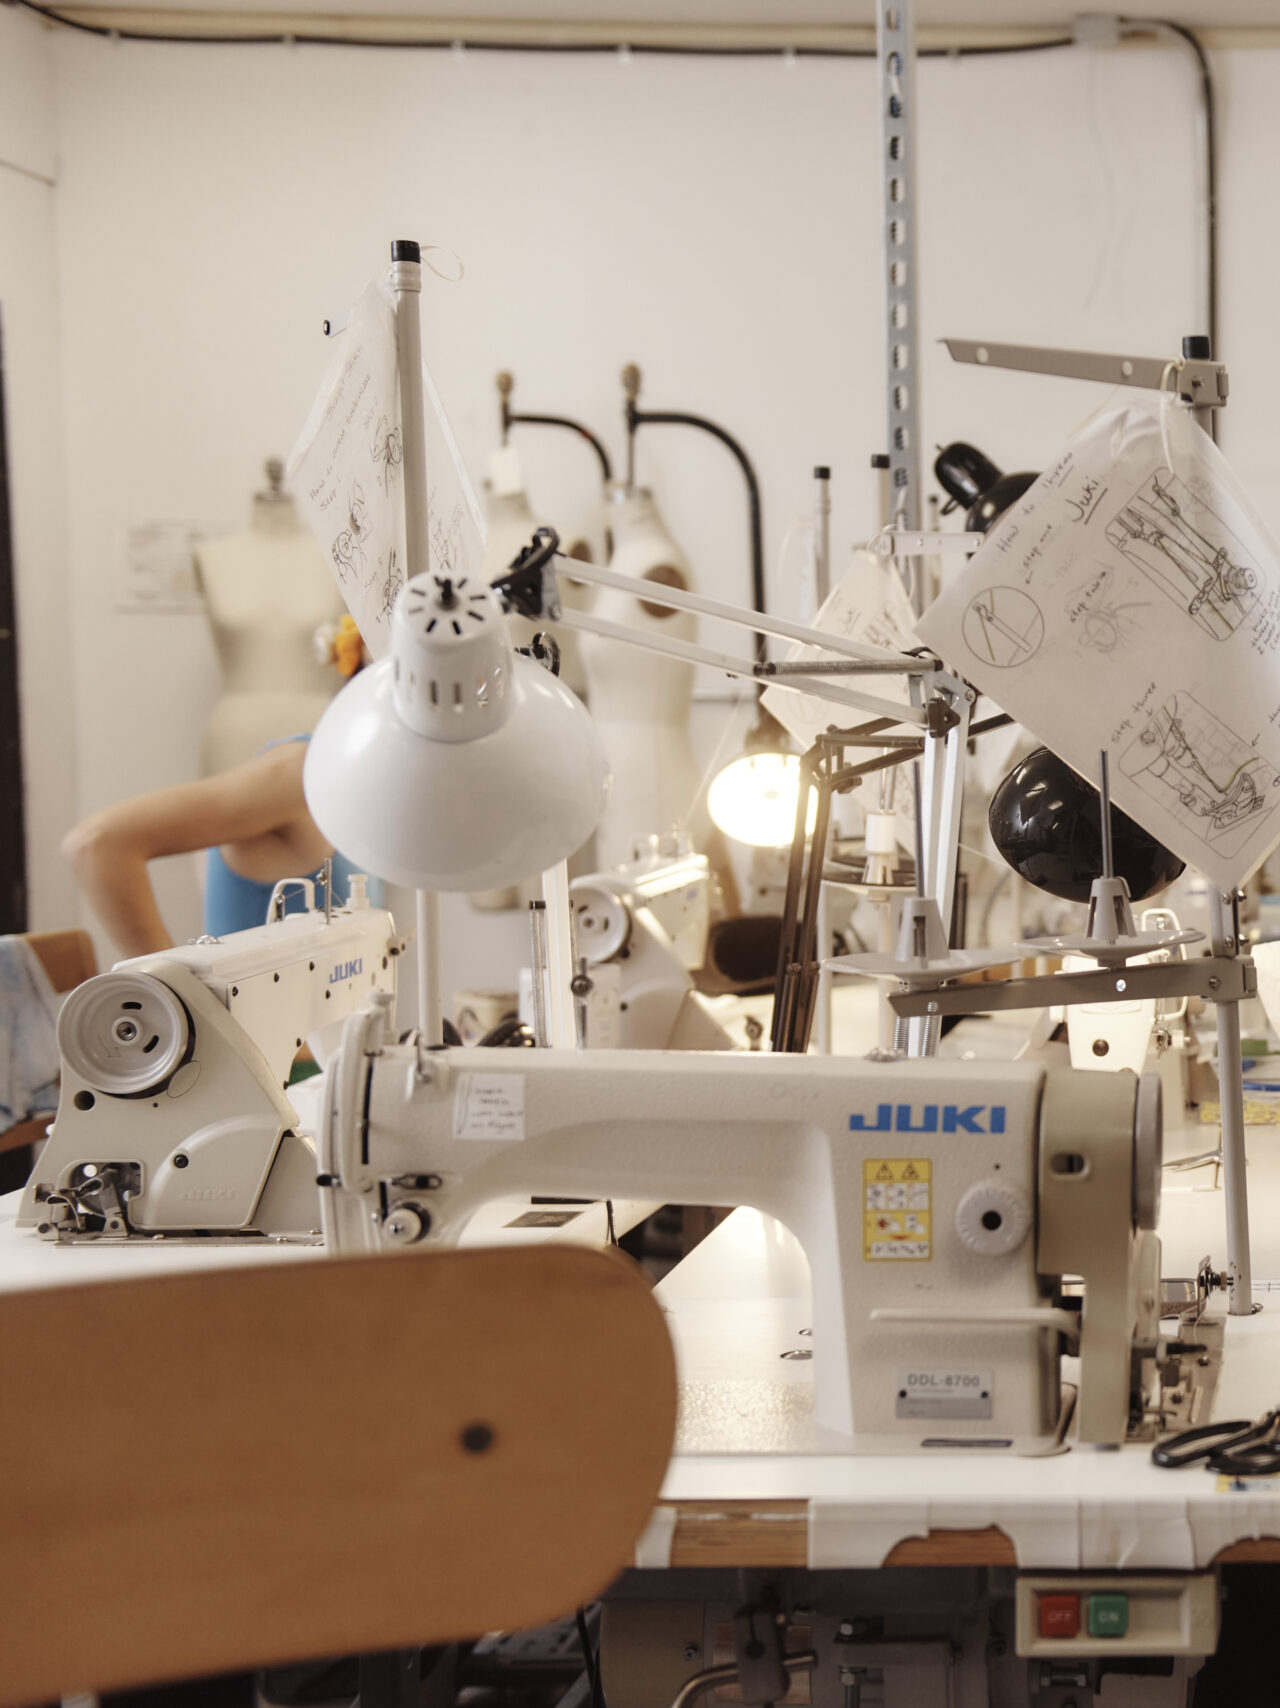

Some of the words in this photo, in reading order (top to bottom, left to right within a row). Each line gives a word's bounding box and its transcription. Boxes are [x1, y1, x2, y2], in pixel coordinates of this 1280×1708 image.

[1064, 475, 1100, 523] Juki
[997, 525, 1019, 553] How
[329, 957, 363, 984] JUKI
[850, 1103, 1006, 1134] JUKI
[907, 1373, 980, 1387] DDL-8700
[1048, 1609, 1073, 1623] OFF
[1098, 1609, 1120, 1623] ON
